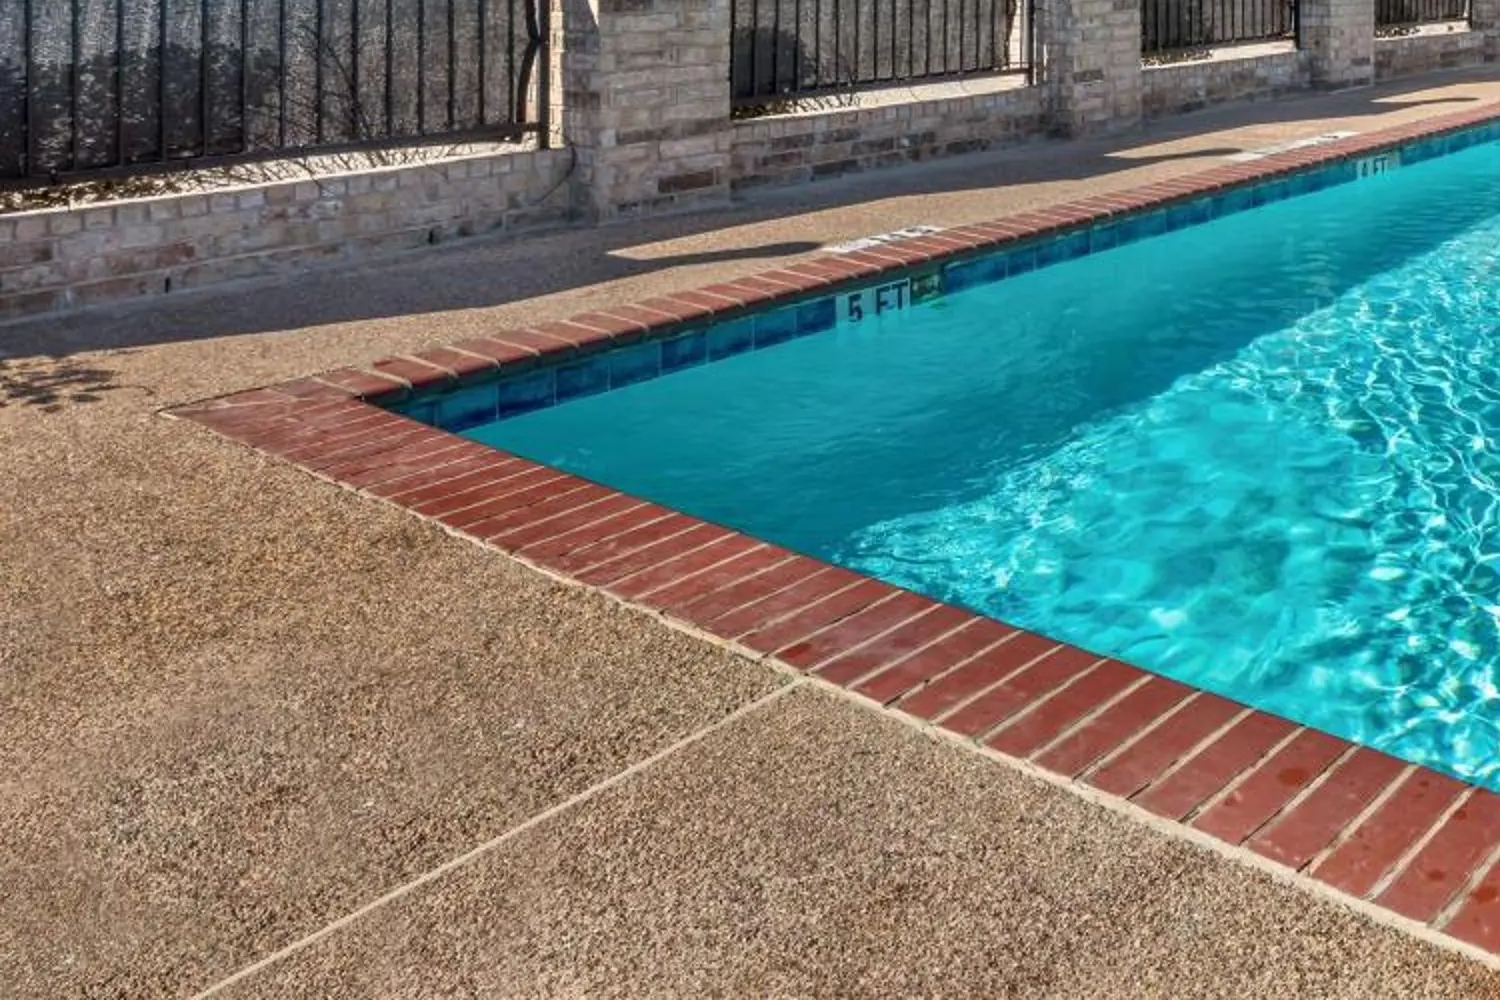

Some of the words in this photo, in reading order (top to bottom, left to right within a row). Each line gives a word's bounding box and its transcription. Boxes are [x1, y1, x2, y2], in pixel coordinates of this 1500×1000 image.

[1373, 156, 1388, 176] FT
[848, 294, 863, 322] 5
[875, 281, 908, 317] FT
